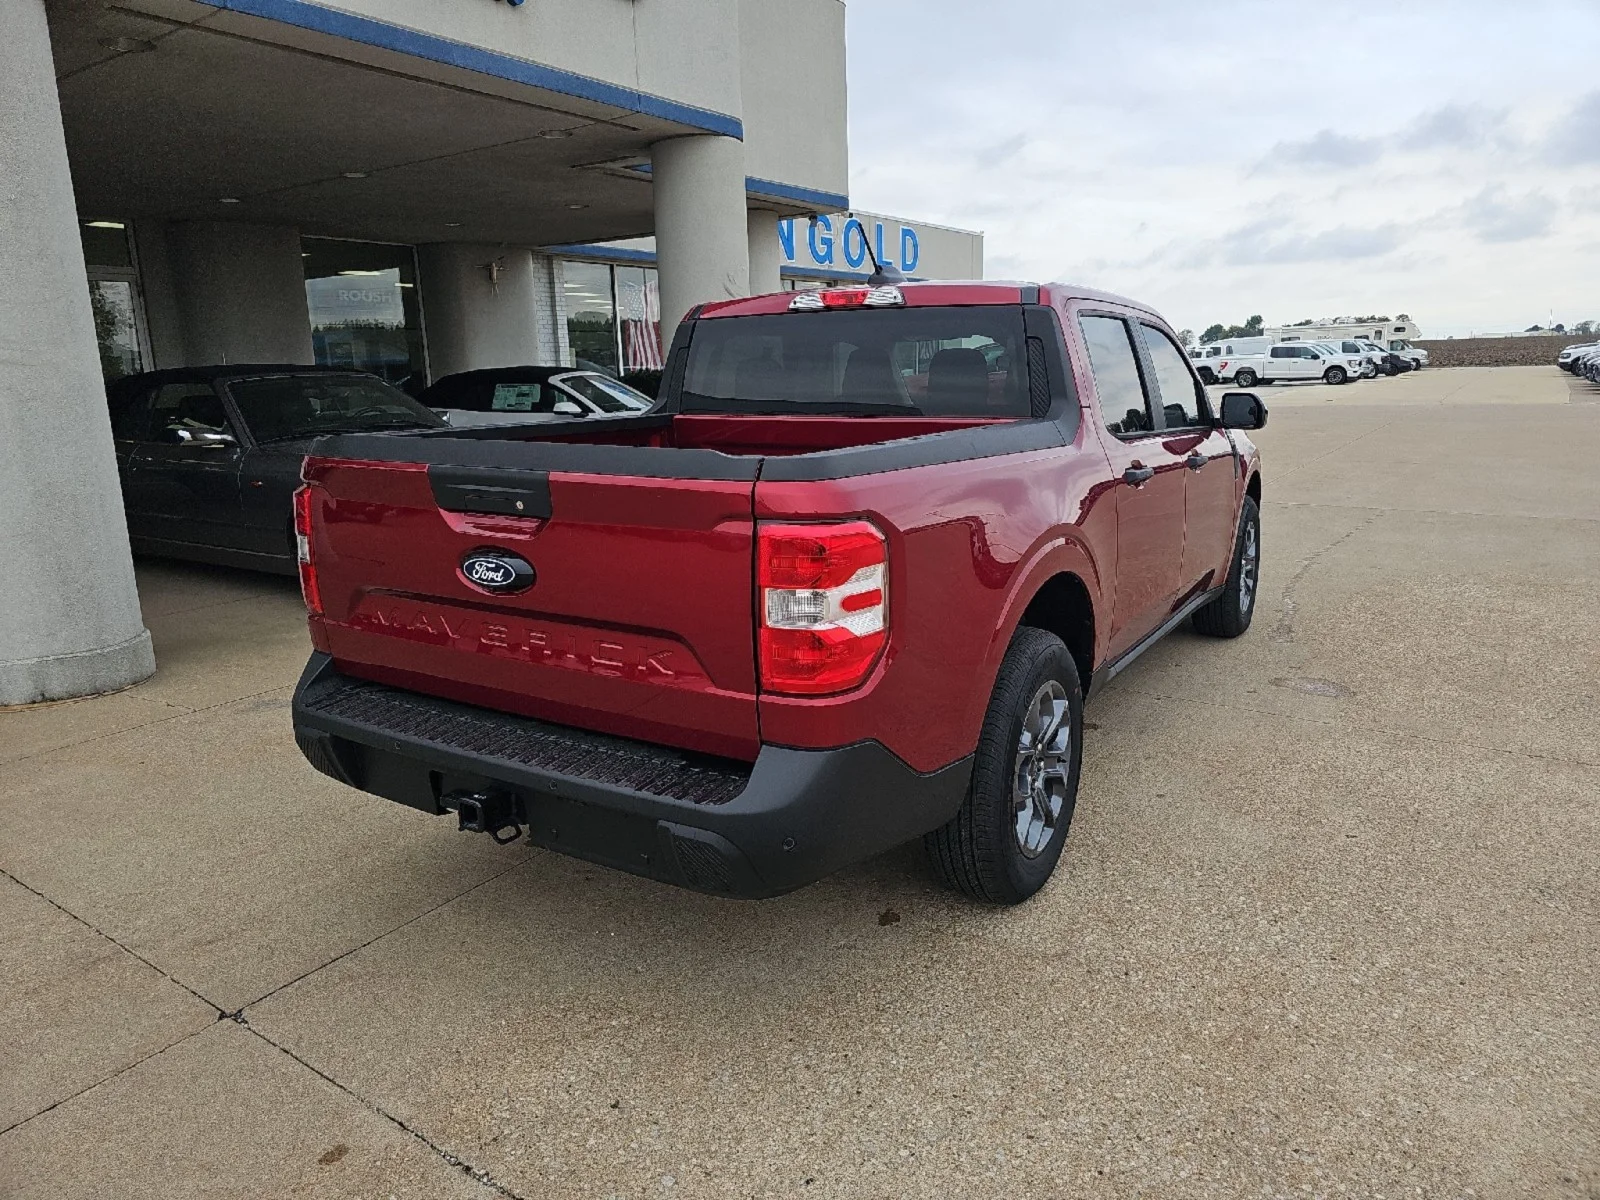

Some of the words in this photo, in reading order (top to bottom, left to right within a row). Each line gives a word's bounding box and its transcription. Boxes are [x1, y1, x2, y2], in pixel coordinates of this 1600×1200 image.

[338, 289, 392, 303] ROUSH
[472, 561, 504, 582] Ford
[359, 606, 674, 674] MAVERICK
